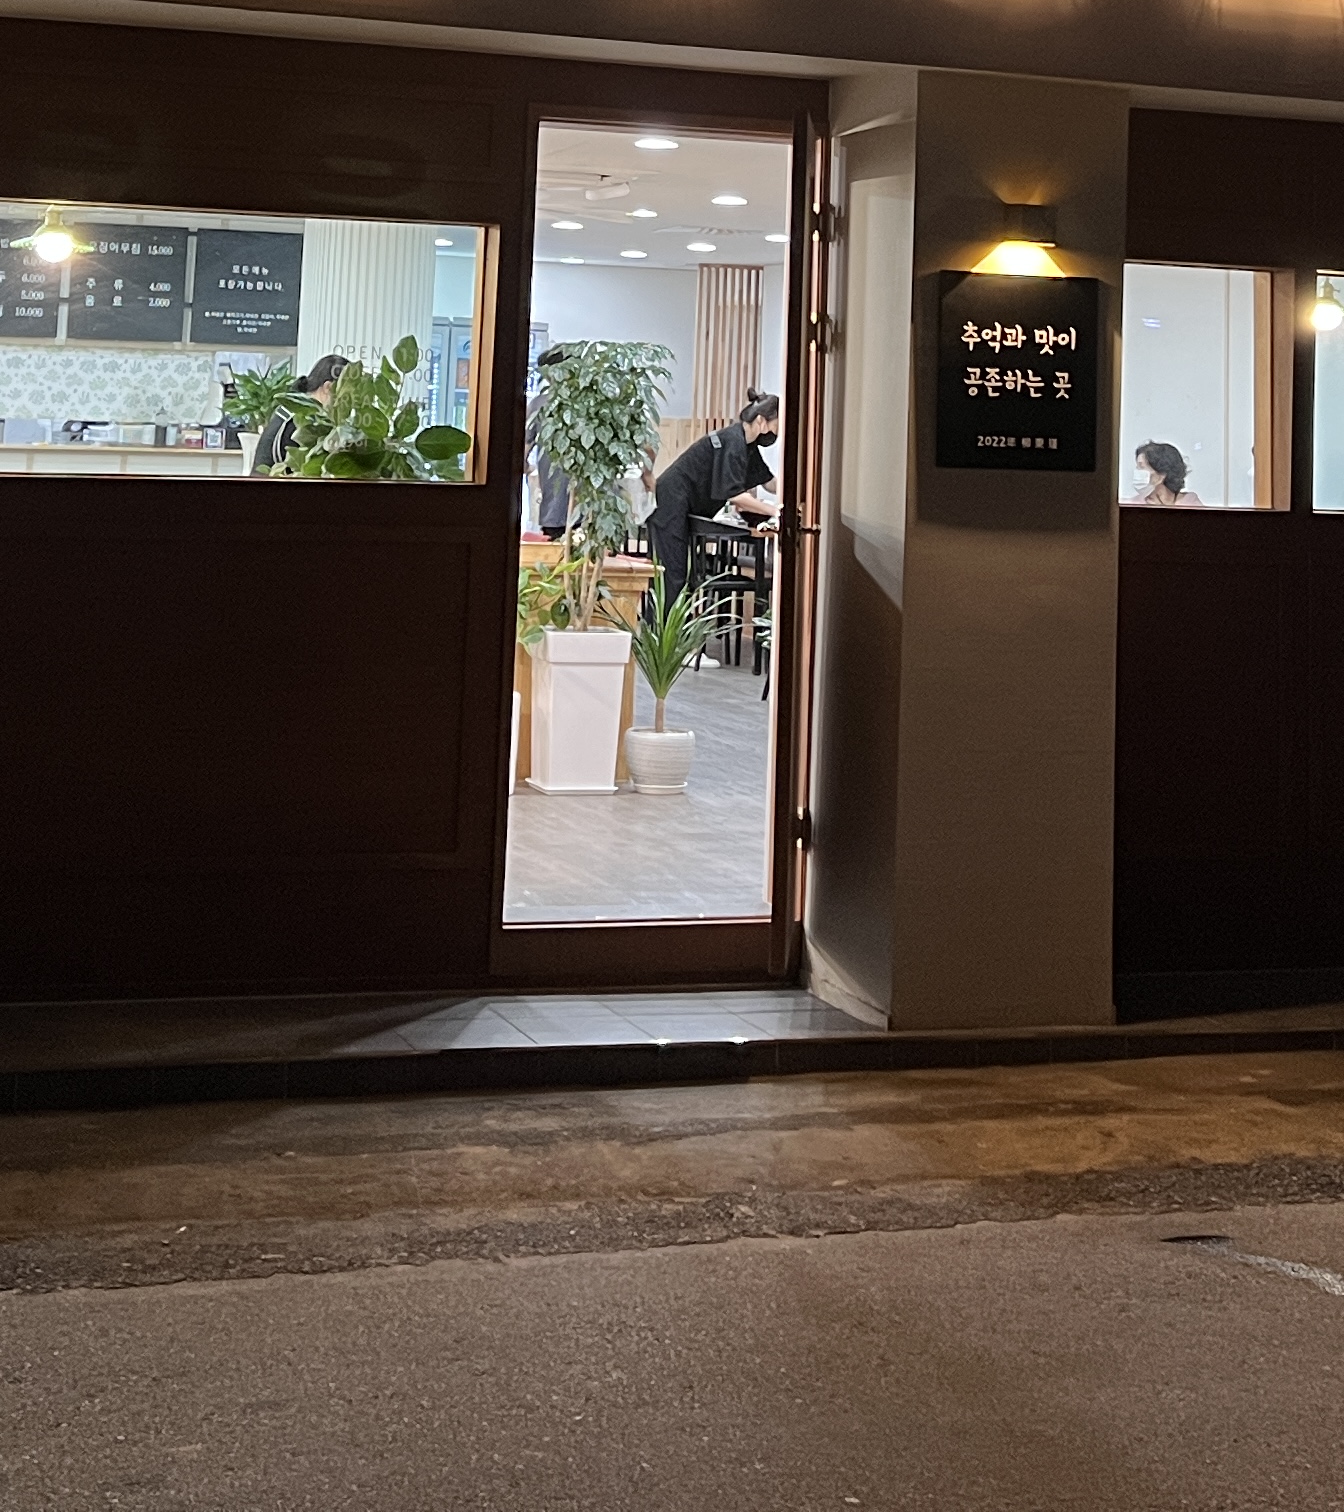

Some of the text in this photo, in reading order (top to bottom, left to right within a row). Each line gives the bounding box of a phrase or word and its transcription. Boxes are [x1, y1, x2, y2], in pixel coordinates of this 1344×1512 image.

[960, 320, 1077, 356] 추억과 맛이
[963, 366, 1072, 400] 공존하는 곳
